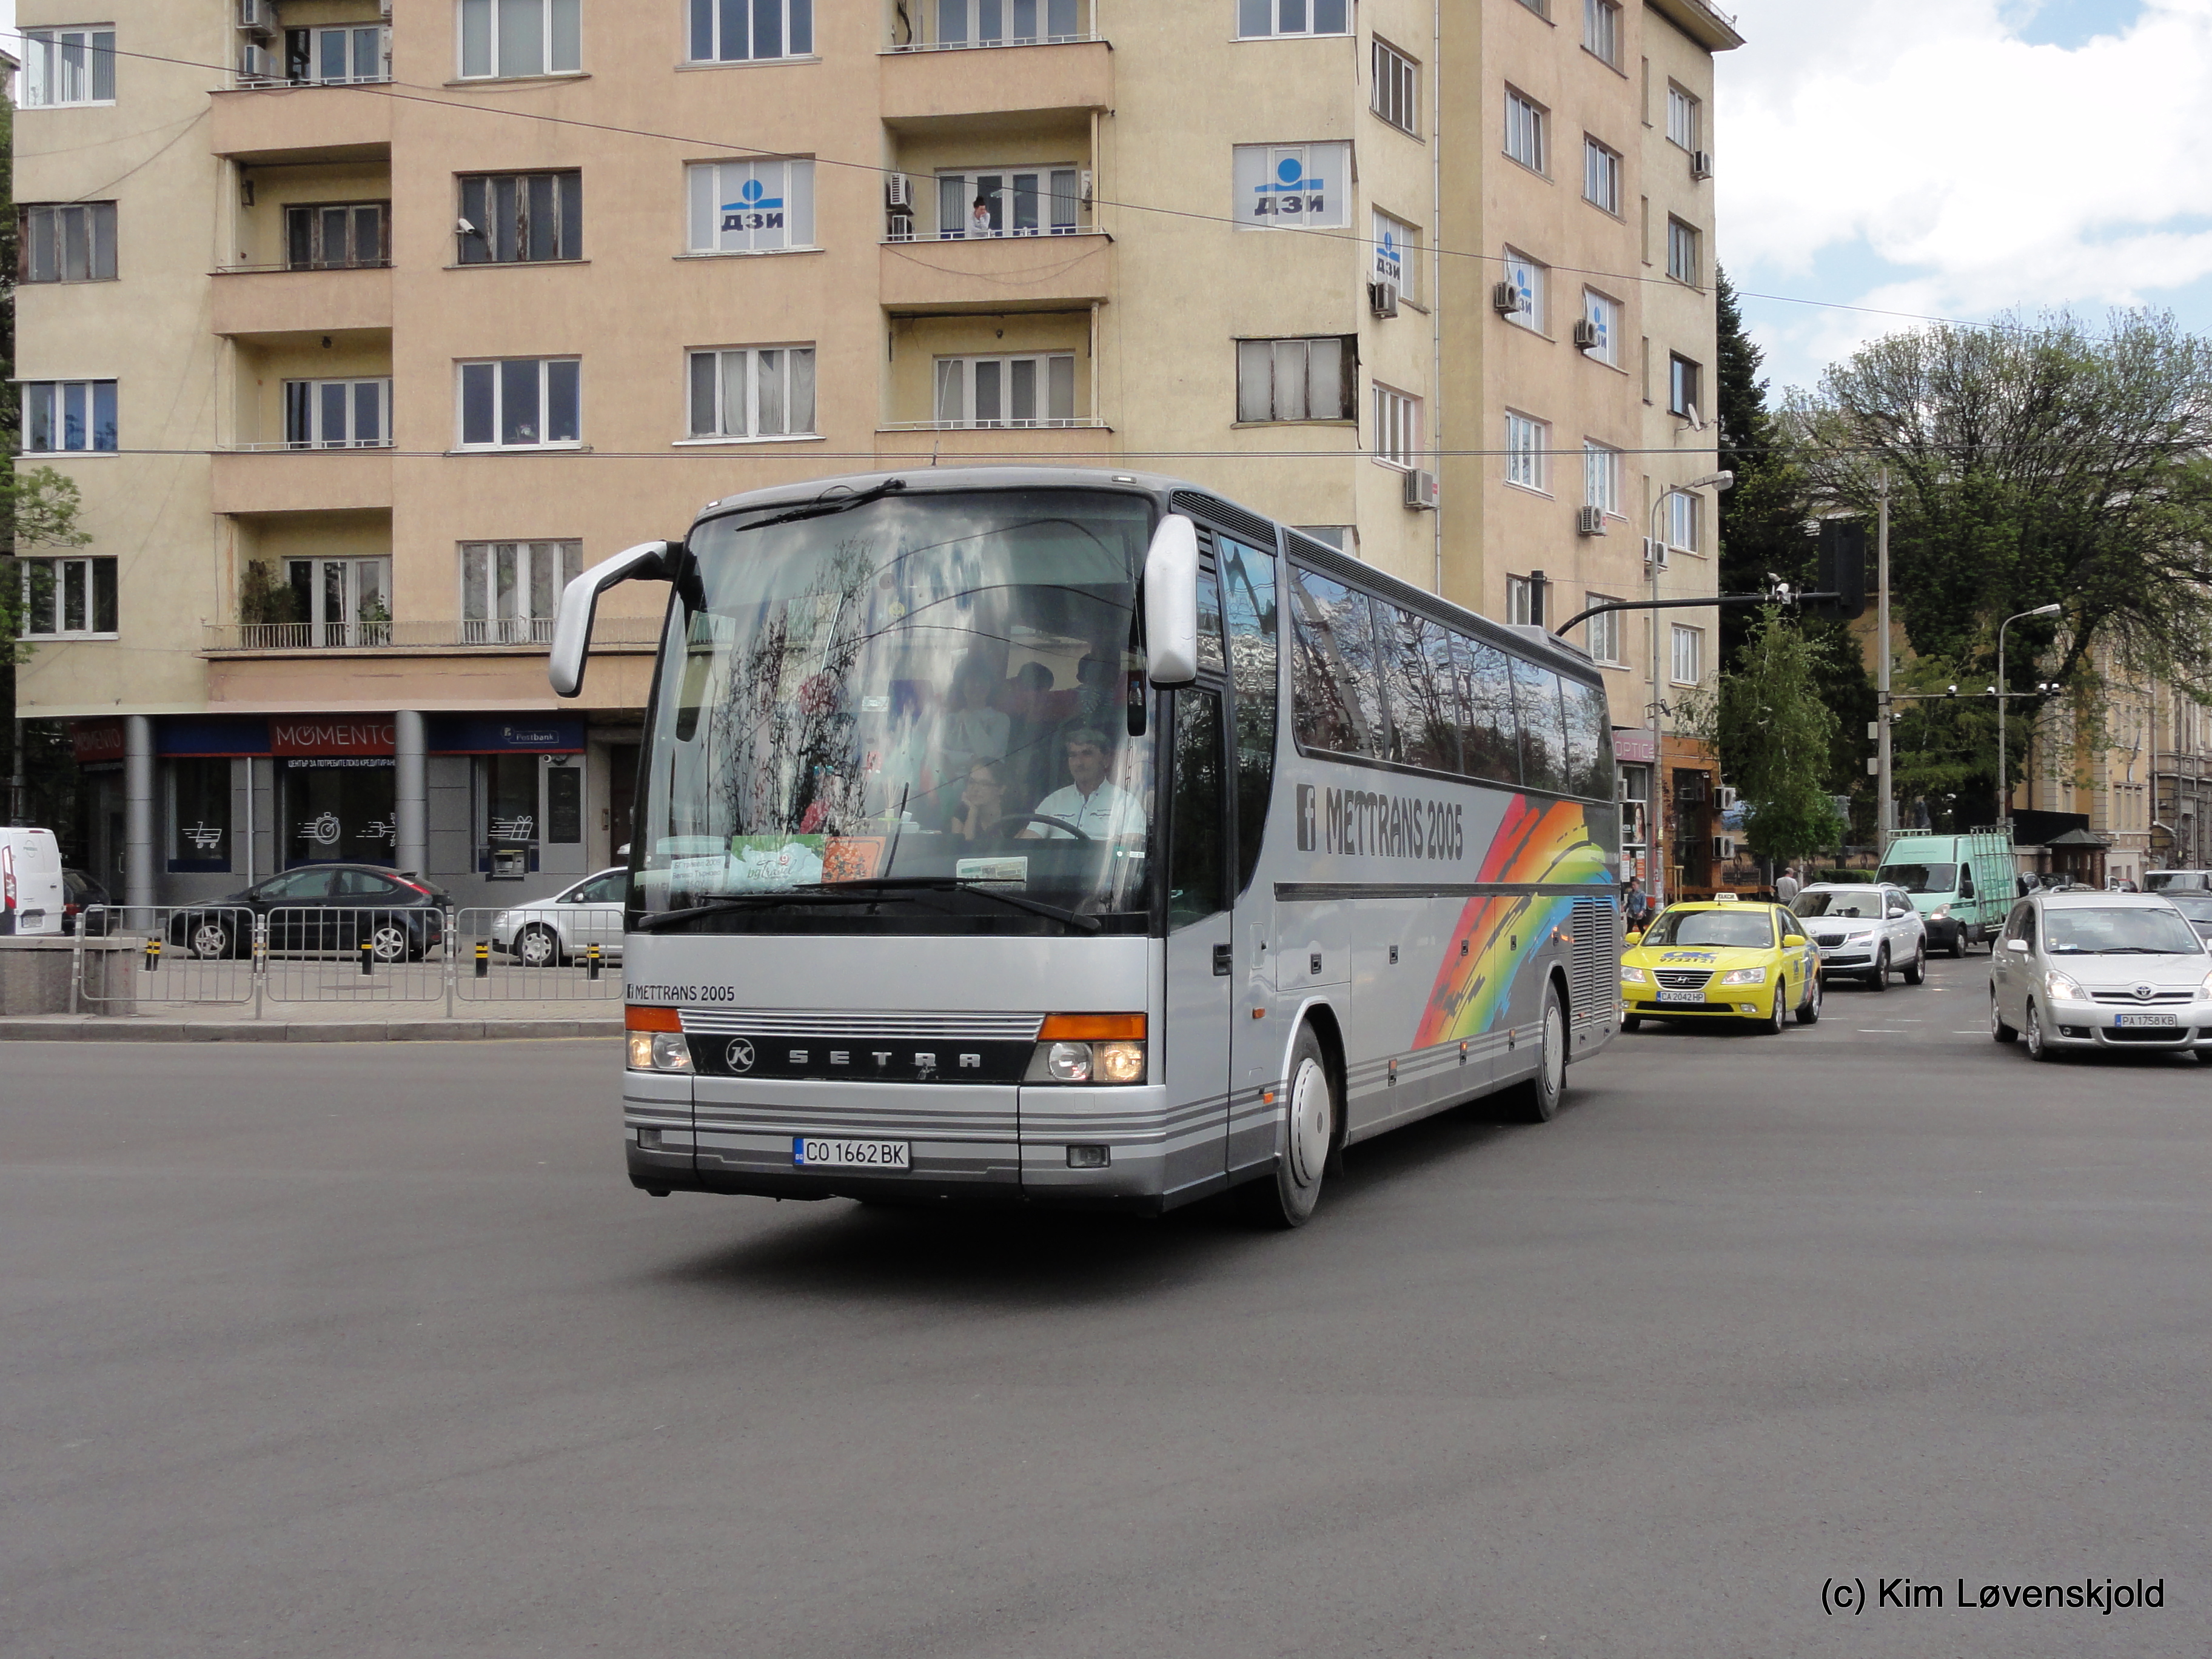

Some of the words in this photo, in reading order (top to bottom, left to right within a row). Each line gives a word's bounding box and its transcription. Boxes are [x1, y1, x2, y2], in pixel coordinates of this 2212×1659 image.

[1254, 195, 1324, 216] ДЗИ
[721, 212, 783, 232] ДЗИ
[1376, 257, 1400, 280] ДЗИ
[1519, 298, 1532, 315] ЗИ
[1326, 787, 1424, 859] METTRANS
[1427, 800, 1463, 860] 2005
[635, 985, 697, 1000] METTRANS
[701, 986, 735, 1001] 2005
[1673, 993, 1692, 1001] 2042
[2138, 1016, 2160, 1025] 1758
[789, 1050, 980, 1067] SETRA
[806, 1142, 829, 1161] CO
[836, 1143, 877, 1163] 1662
[881, 1144, 905, 1164] BK
